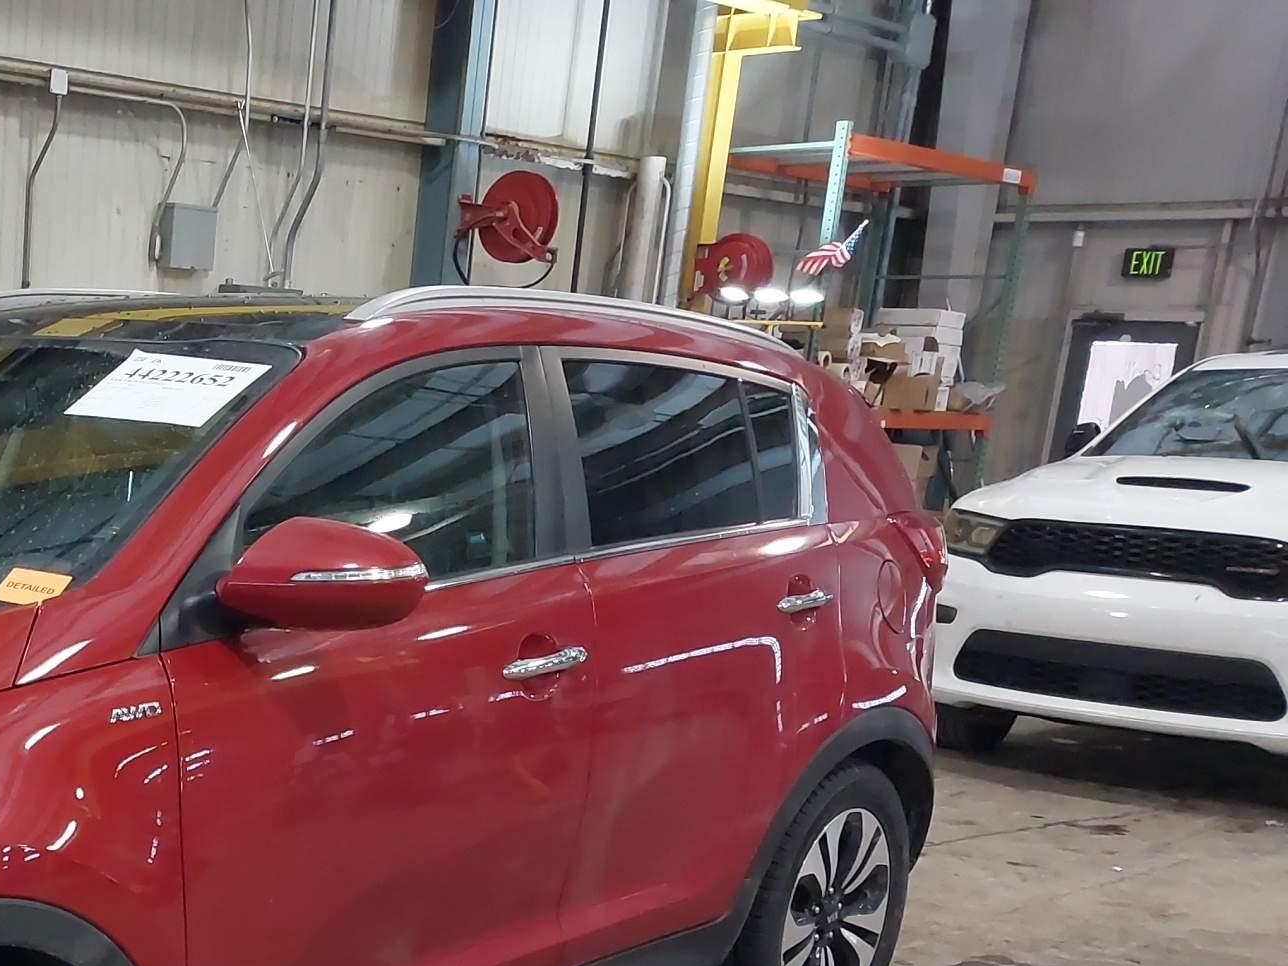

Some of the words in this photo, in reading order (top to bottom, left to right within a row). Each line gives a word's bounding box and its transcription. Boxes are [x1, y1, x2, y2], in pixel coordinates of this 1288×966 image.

[1129, 250, 1166, 275] EXIT
[123, 367, 236, 387] 44222652
[6, 581, 56, 595] DETAILED
[110, 701, 162, 723] AWD
